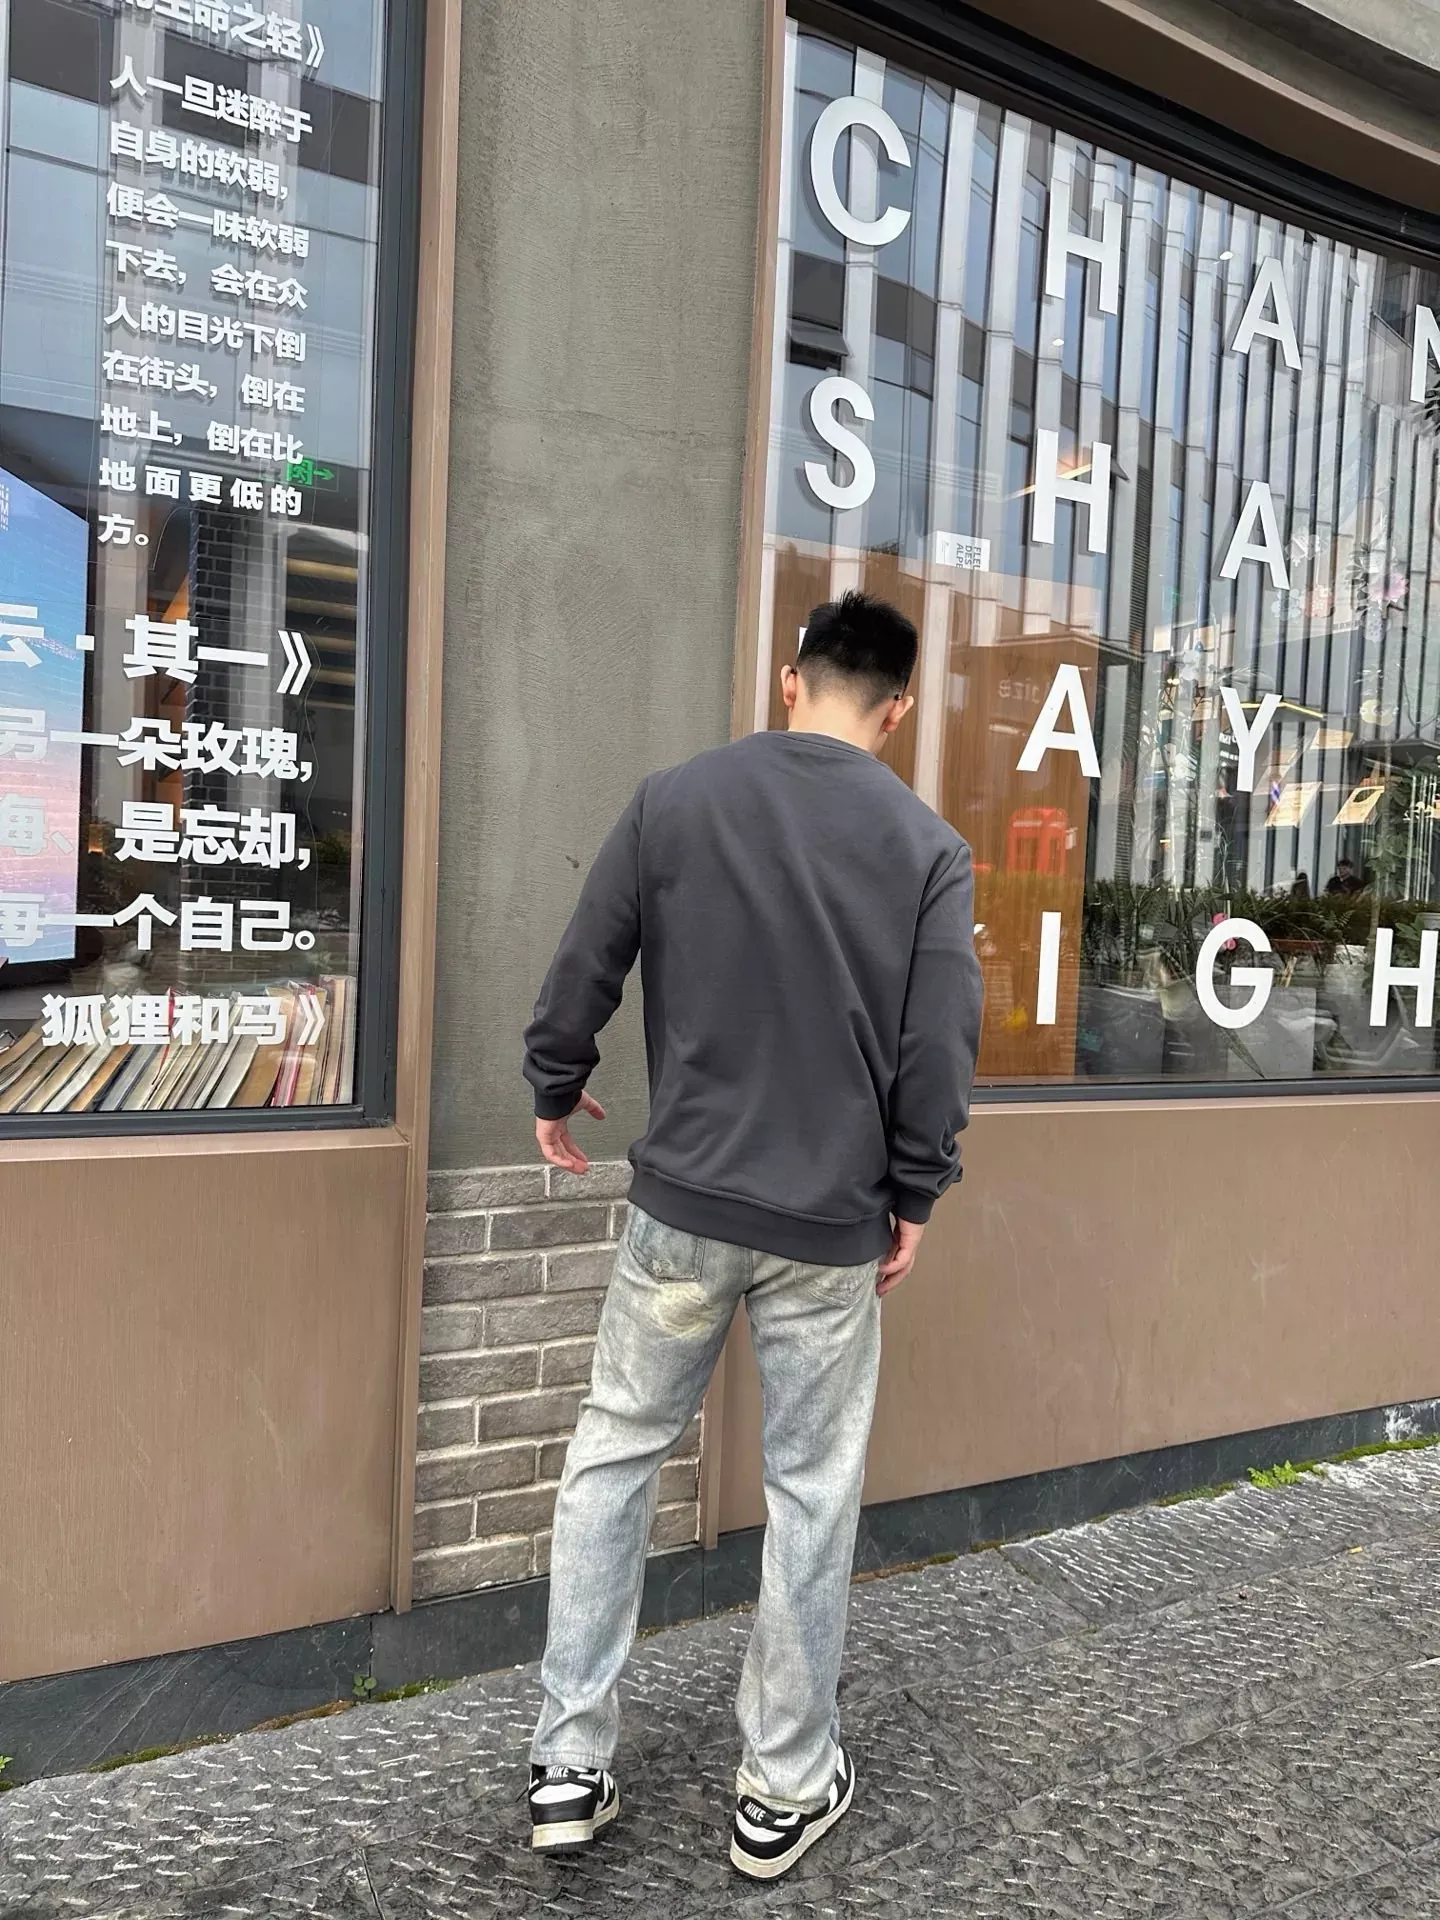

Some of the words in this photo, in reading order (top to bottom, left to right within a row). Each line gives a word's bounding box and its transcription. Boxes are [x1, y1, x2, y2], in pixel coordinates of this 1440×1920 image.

[110, 55, 313, 143] 人一旦迷醉于
[106, 182, 310, 259] 便会一味软弱
[103, 295, 307, 361] 人的目光下倒
[97, 512, 150, 547] 方。
[964, 545, 973, 565] DES
[546, 1766, 569, 1780] NIKE
[744, 1801, 767, 1822] NIKE
